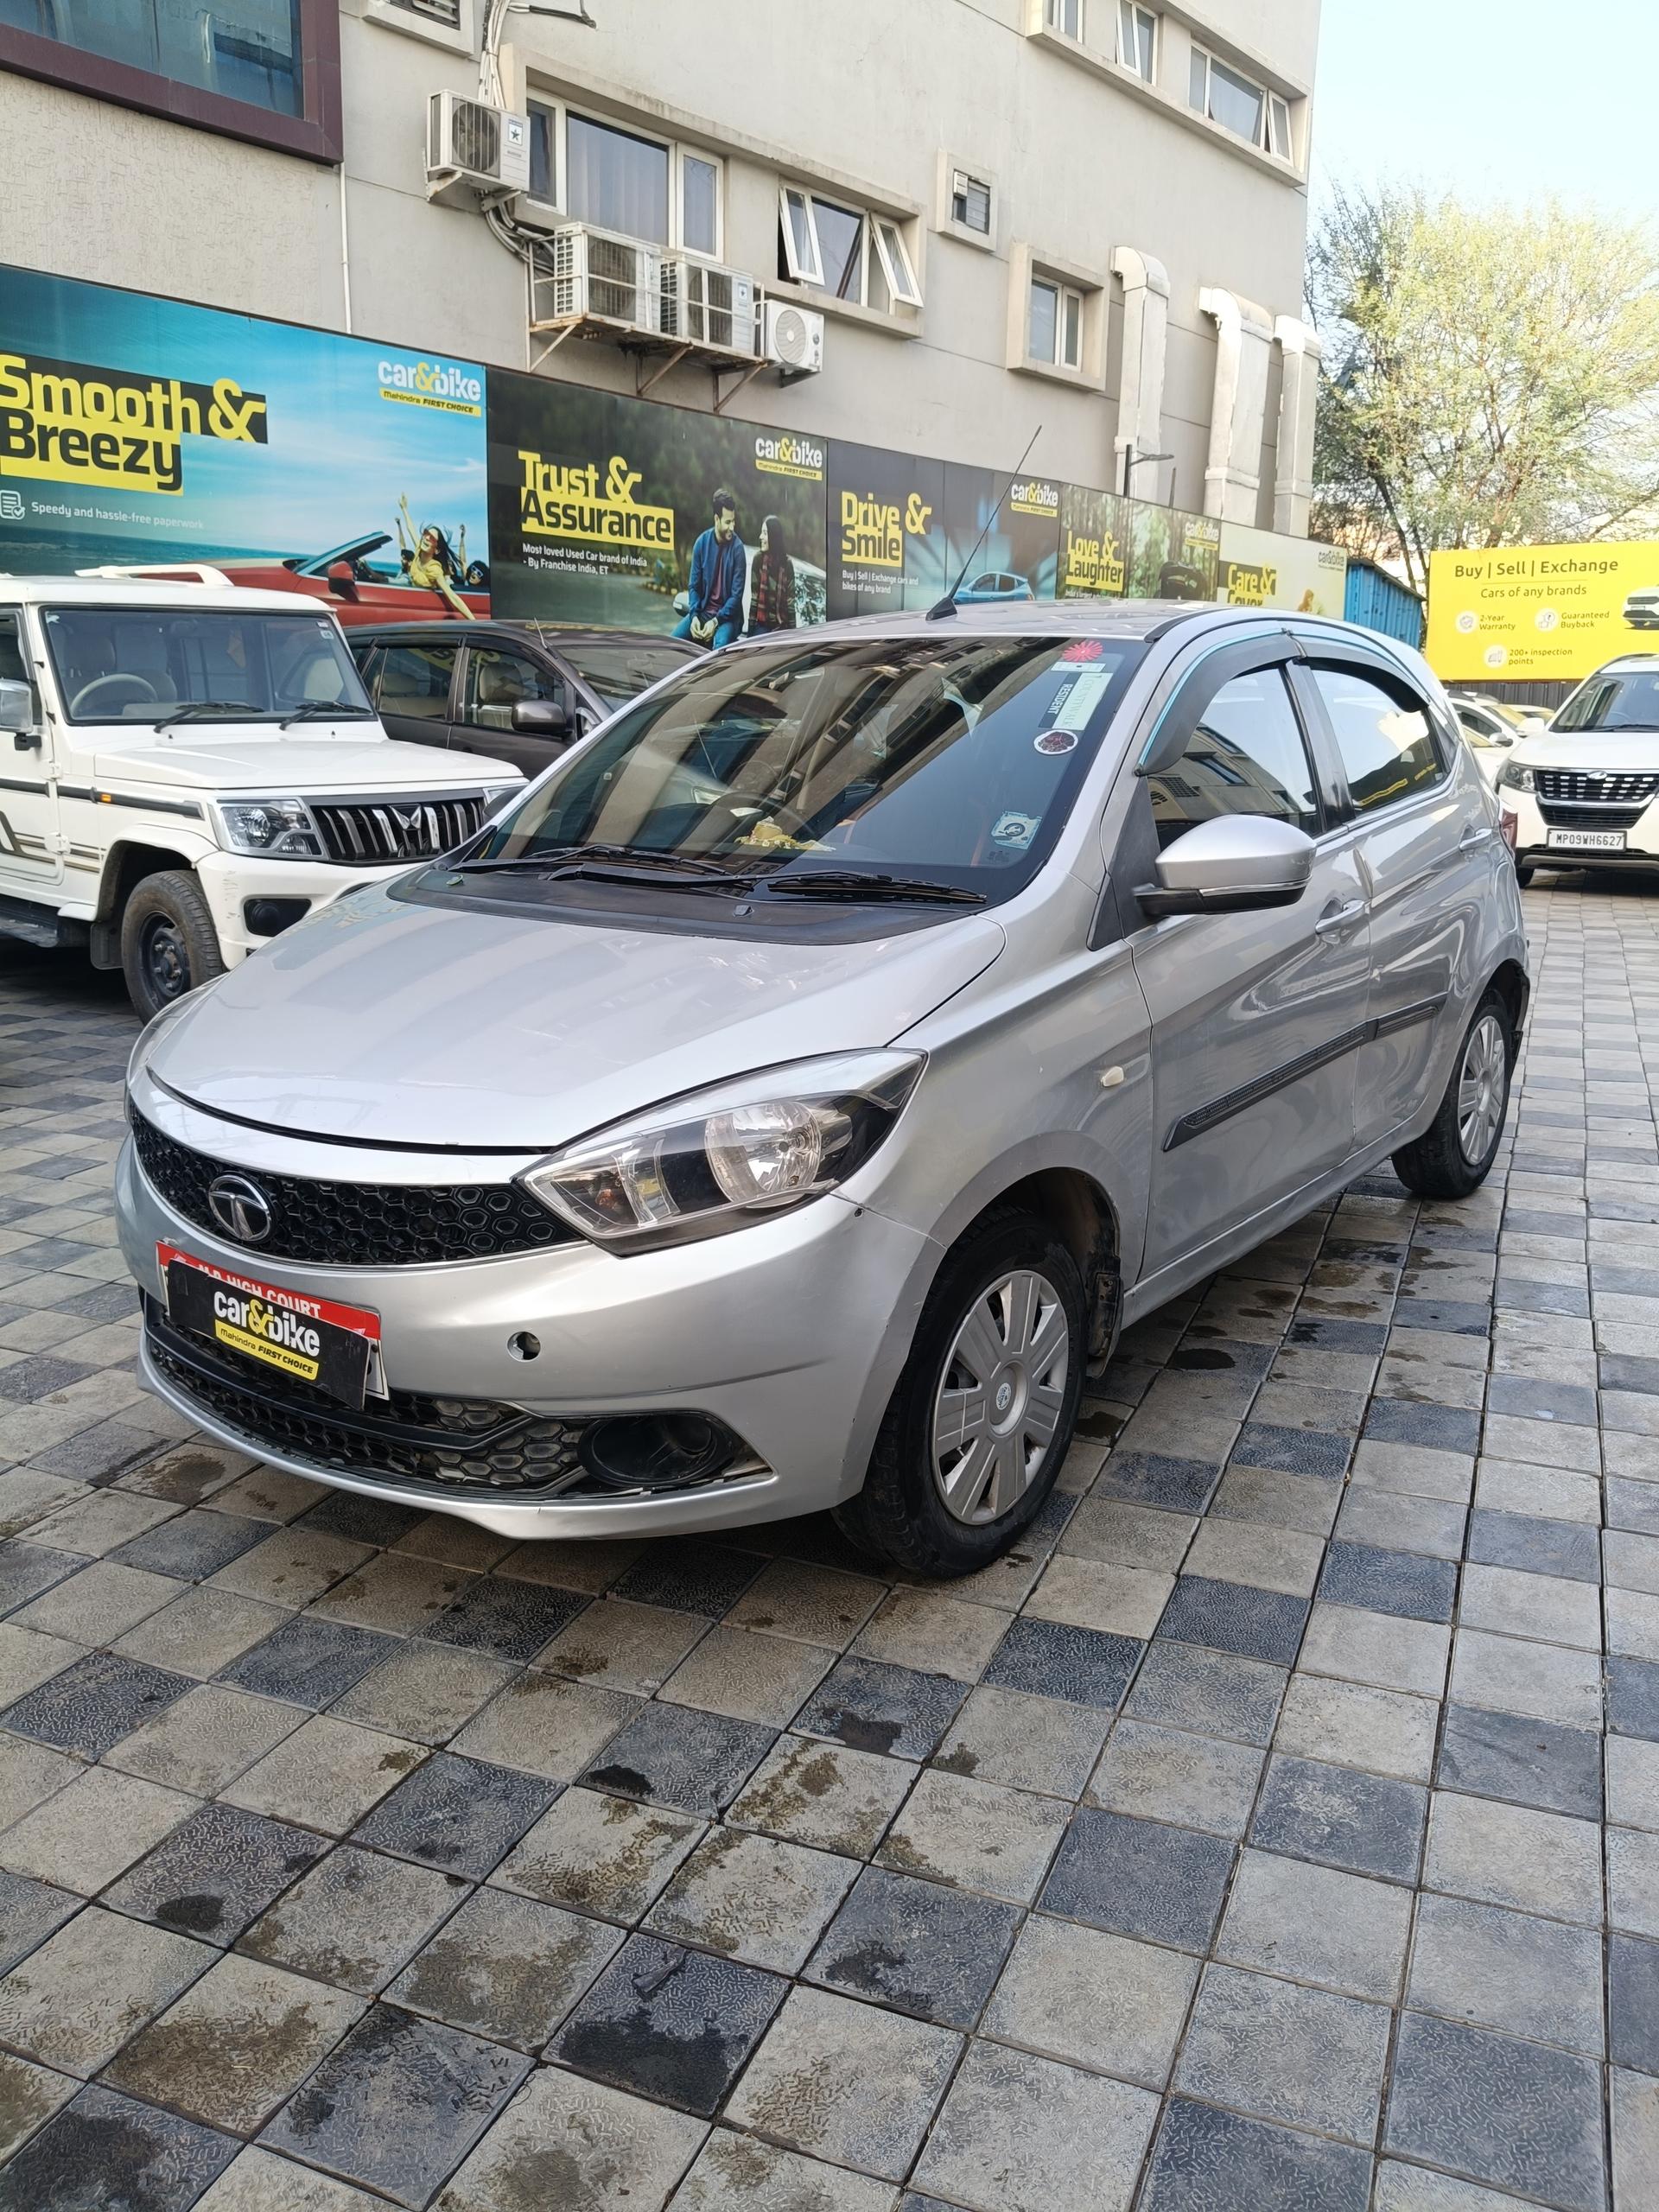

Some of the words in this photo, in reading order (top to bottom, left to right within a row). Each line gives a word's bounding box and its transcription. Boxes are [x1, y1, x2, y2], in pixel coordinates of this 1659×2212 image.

[378, 361, 481, 402] car&bike
[0, 354, 200, 435] Smooth
[208, 378, 265, 442] &
[423, 398, 446, 409] FIRST
[446, 403, 474, 413] CHOICE
[0, 406, 181, 491] Breezy
[755, 437, 823, 468] car&bike
[518, 449, 600, 499] Trust
[606, 455, 642, 505] &
[31, 501, 72, 518] Speedy
[73, 507, 93, 518] and
[96, 508, 151, 524] hassle-free
[153, 516, 204, 530] paperwork
[519, 489, 671, 543] Assurance
[842, 491, 899, 528] Drive
[906, 493, 932, 535] &
[523, 542, 543, 555] Most
[543, 545, 564, 557] loved
[566, 548, 584, 560] Used
[586, 551, 598, 562] Car
[600, 551, 620, 564] brand
[621, 555, 629, 564] of
[630, 556, 647, 568] India
[842, 524, 900, 562] Smile
[1067, 530, 1100, 558] Love
[1102, 531, 1120, 560] &
[528, 556, 538, 570] By
[540, 558, 576, 572] Franchise
[578, 563, 598, 575] India,
[600, 565, 609, 575] ET
[842, 569, 854, 582] Buy
[857, 571, 868, 581] Sell
[871, 572, 896, 585] Exchange
[909, 576, 919, 586] and
[1066, 553, 1123, 586] Laughter
[1228, 563, 1259, 593] Care
[1260, 565, 1276, 595] &
[1455, 564, 1483, 580] Buy
[1497, 561, 1526, 575] Sell
[1541, 558, 1618, 575] Exchange
[842, 581, 857, 591] bikes
[857, 582, 864, 591] of
[864, 583, 874, 594] any
[875, 583, 891, 594] brand
[1480, 588, 1505, 599] Cars
[1508, 587, 1521, 597] of
[1523, 588, 1544, 599] any
[1547, 584, 1587, 596] brands
[1479, 622, 1516, 631] Warranty
[1560, 620, 1595, 630] Buyback
[1561, 611, 1610, 620] Guaranteed
[1530, 648, 1573, 657] inspection
[1047, 683, 1073, 715] RESIDENT
[1555, 834, 1623, 847] MP09WH6627
[267, 1289, 321, 1319] COURT
[213, 1291, 321, 1357] car&bike
[258, 1344, 283, 1361] FIRST
[283, 1356, 314, 1374] CHOICE
